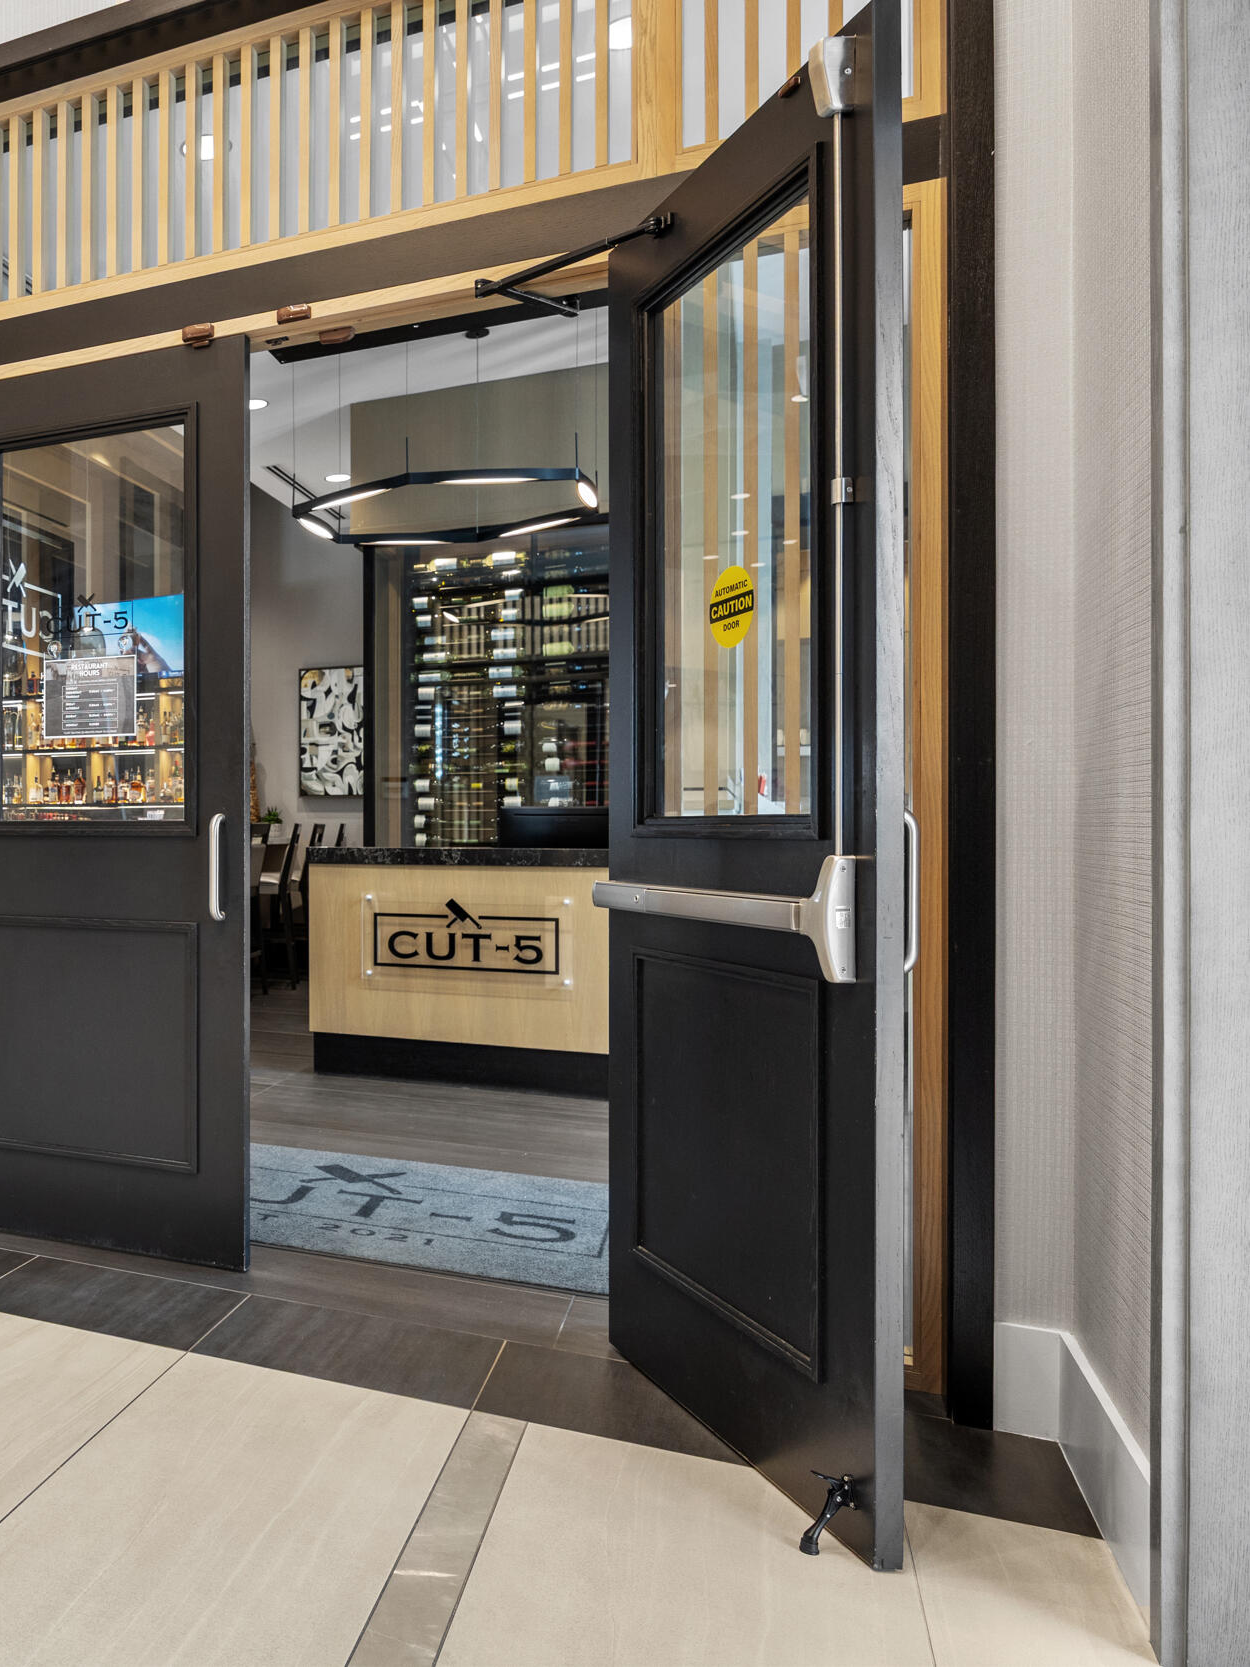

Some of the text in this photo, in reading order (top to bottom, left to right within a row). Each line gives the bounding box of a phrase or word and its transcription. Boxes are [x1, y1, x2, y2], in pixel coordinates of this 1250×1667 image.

[715, 579, 748, 597] AUTOMATIC
[711, 594, 752, 619] CAUTION
[46, 611, 128, 634] CUT-5
[723, 620, 739, 631] DOOR
[387, 930, 543, 965] CUT-5
[250, 1184, 576, 1243] UT-5
[319, 1222, 434, 1246] 2021
